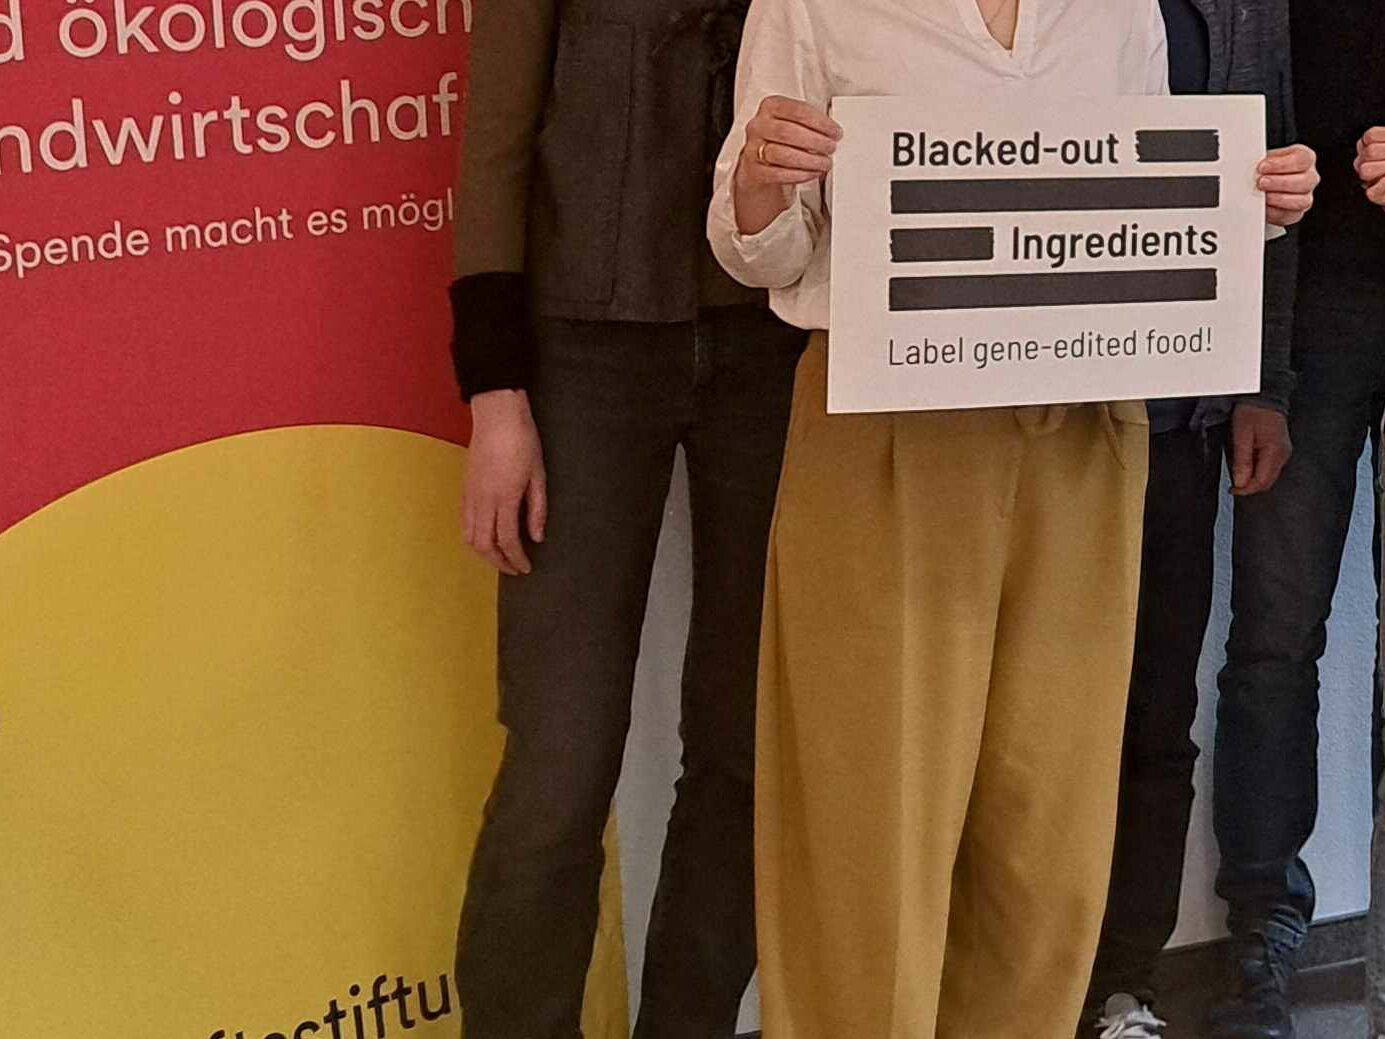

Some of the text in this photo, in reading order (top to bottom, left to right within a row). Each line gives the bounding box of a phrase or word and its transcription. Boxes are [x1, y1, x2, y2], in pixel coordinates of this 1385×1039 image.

[0, 71, 465, 174] ndwirtschaf
[892, 131, 1120, 167] Blacked-out
[165, 207, 294, 254] macht
[306, 211, 349, 238] es
[1012, 224, 1219, 269] Ingredients
[888, 326, 1213, 369] Label gene-edited food!
